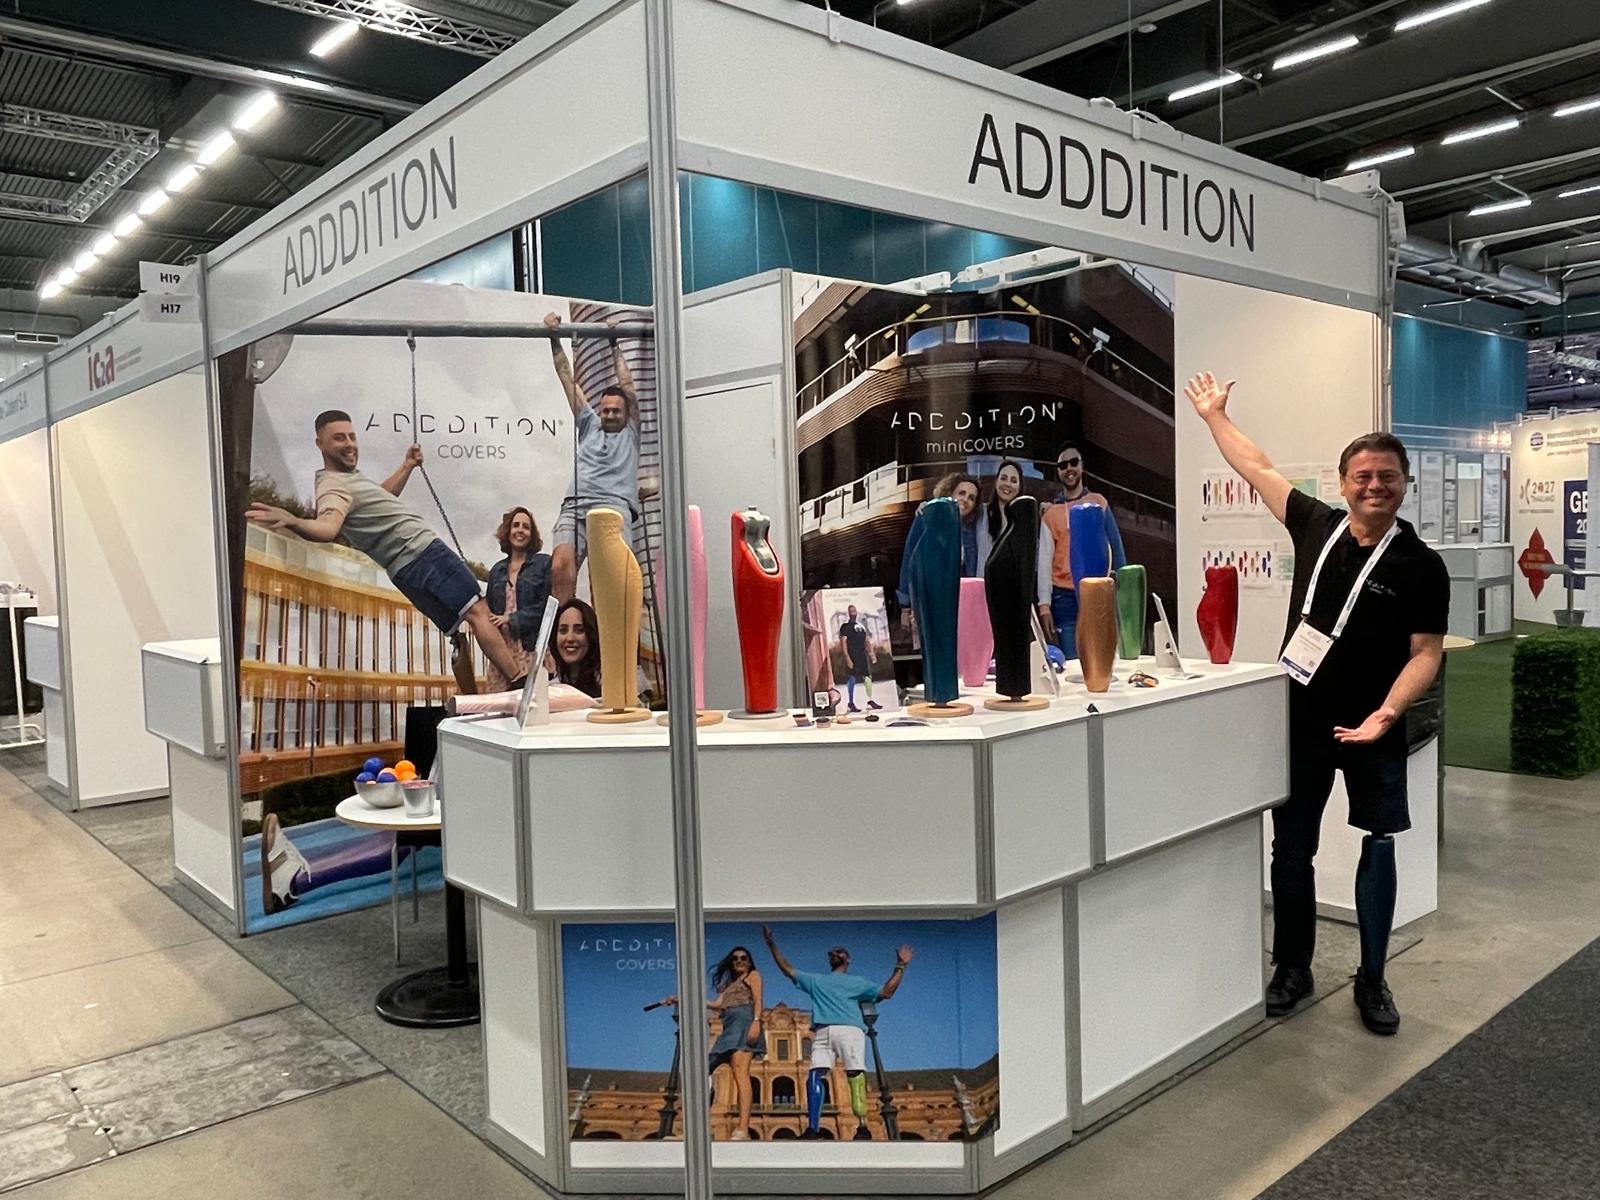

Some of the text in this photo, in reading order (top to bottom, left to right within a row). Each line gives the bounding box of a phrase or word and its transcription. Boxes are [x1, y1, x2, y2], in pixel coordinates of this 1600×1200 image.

[967, 112, 1254, 253] ADDDITION
[283, 135, 457, 295] ADDDITION
[160, 272, 181, 284] H19
[160, 303, 181, 314] H17
[437, 444, 506, 460] COVERS
[926, 434, 1025, 454] miniCOVERS
[616, 959, 675, 970] COVERS
